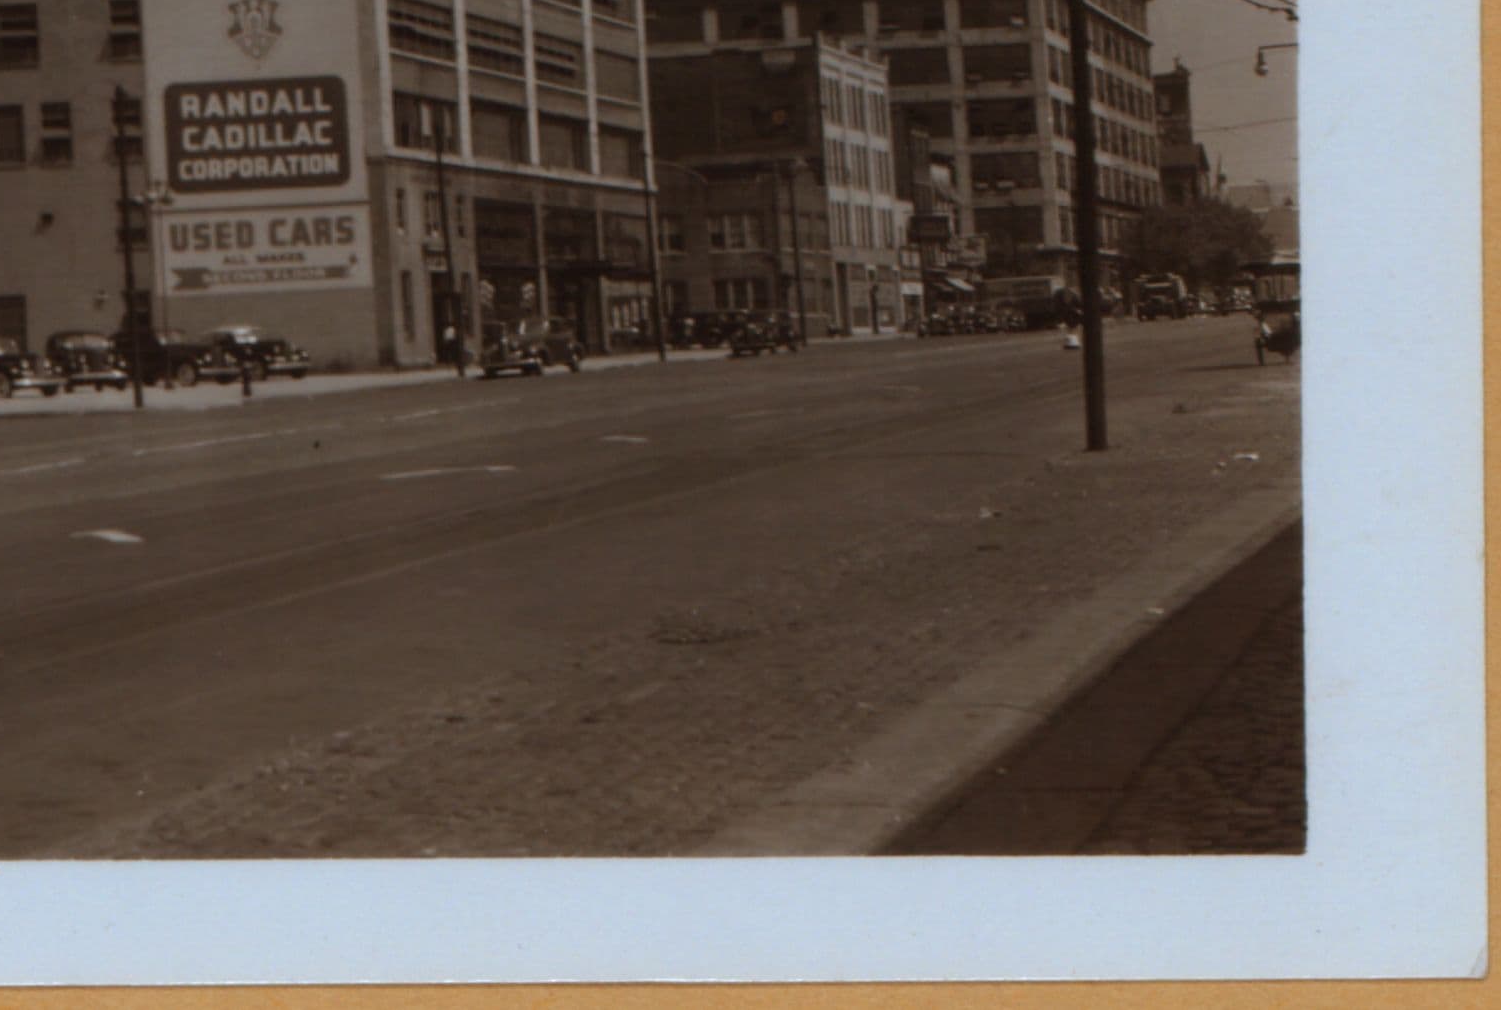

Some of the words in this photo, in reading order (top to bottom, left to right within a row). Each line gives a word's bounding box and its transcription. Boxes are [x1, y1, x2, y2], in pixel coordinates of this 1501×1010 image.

[180, 88, 333, 119] RANDALL
[181, 120, 333, 152] CADILLAC
[178, 152, 340, 181] CORPORATION
[169, 219, 254, 252] USED
[268, 215, 356, 247] CARS
[223, 253, 248, 265] ALL
[256, 251, 306, 263] MAKES
